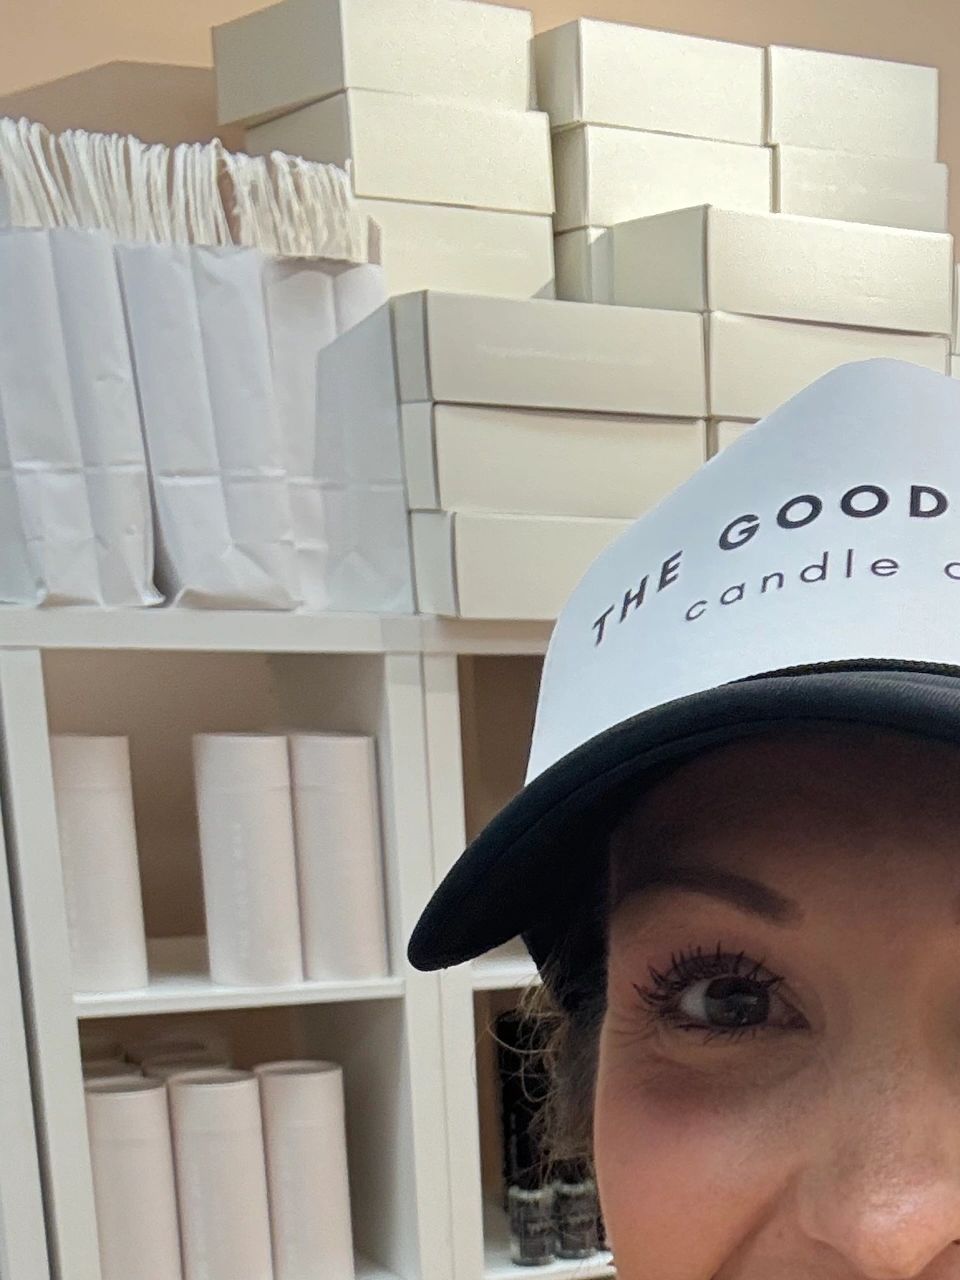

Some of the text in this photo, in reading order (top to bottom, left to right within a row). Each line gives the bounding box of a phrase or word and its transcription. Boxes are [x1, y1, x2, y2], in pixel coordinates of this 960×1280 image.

[591, 550, 683, 647] THE
[718, 484, 950, 551] GOOD
[684, 548, 900, 622] candle
